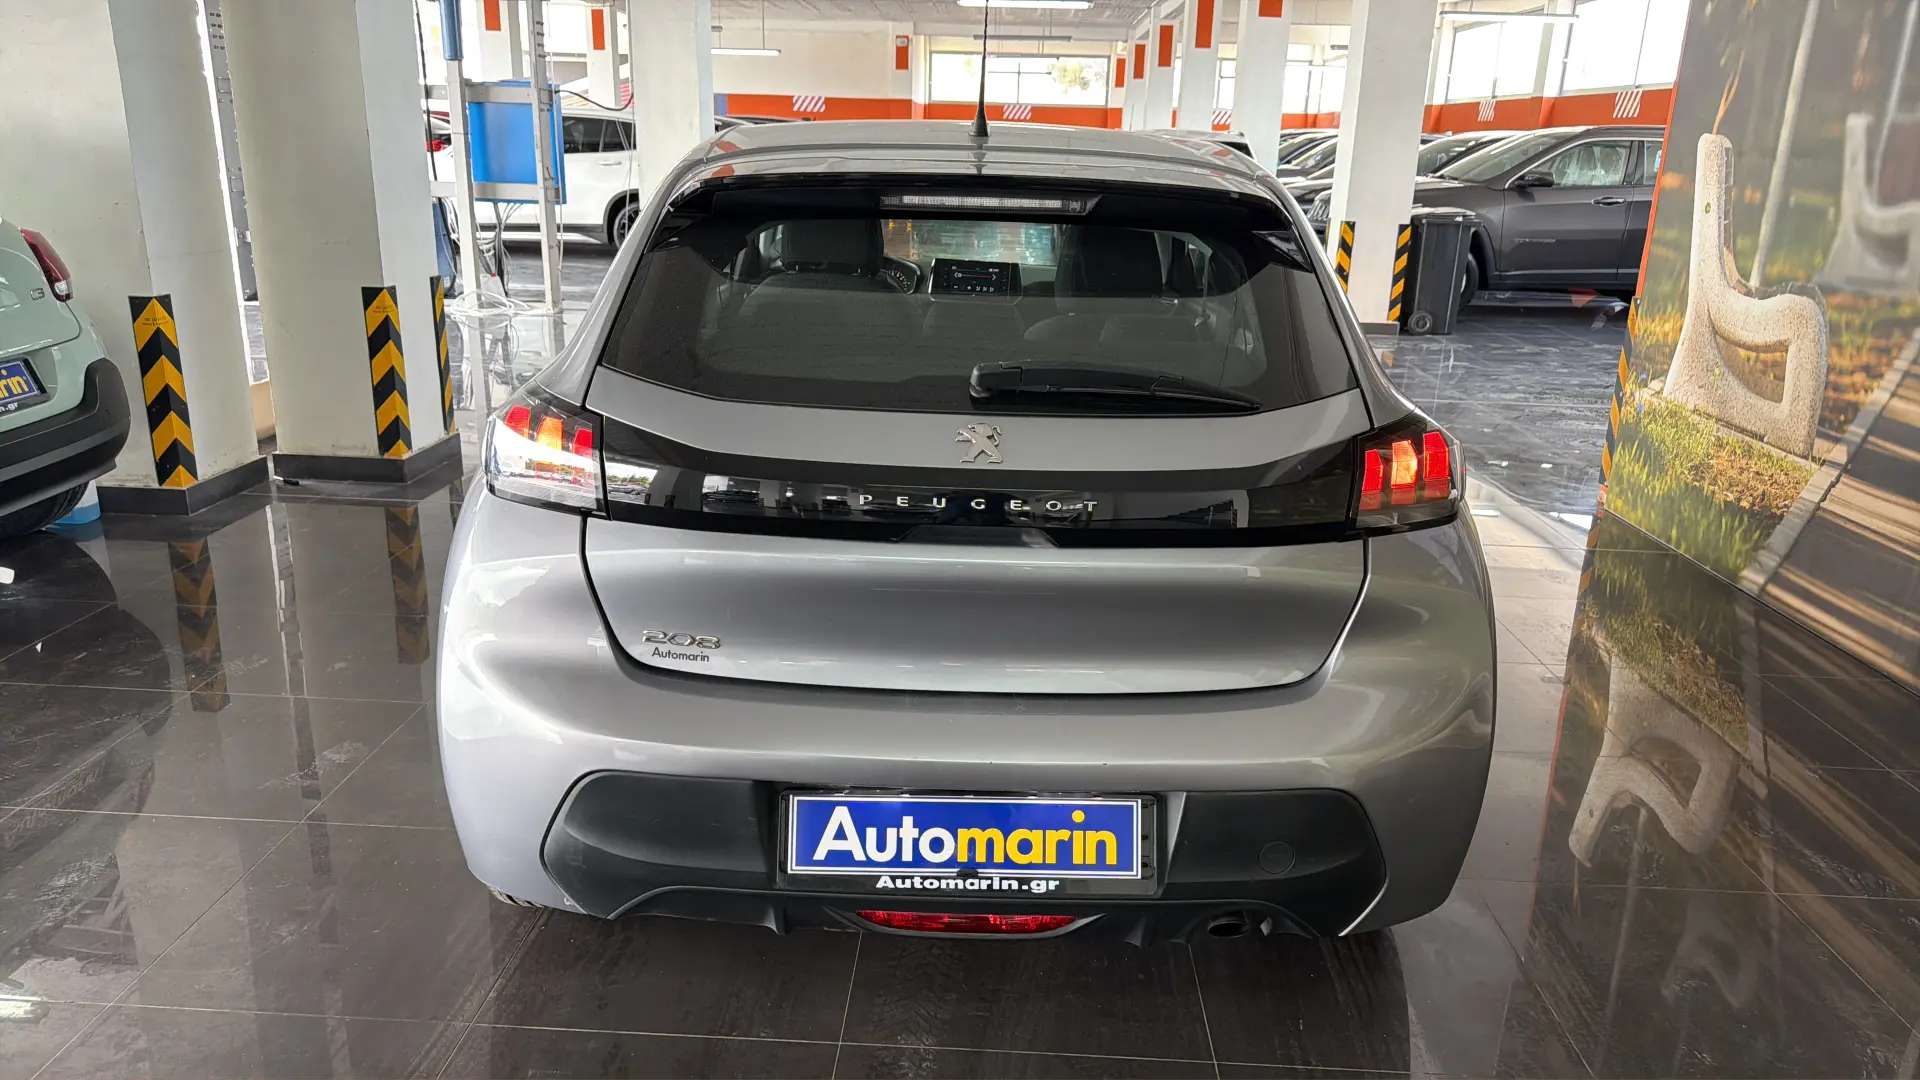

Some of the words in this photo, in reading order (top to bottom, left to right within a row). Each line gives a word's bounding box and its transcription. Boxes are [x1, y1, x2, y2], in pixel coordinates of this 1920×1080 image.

[0, 369, 29, 398] rin
[859, 494, 1098, 512] PEUGEOT
[642, 629, 721, 650] 208
[651, 646, 710, 662] Automarin
[812, 805, 1118, 865] Automarin
[876, 875, 1060, 894] Automarin.gr
